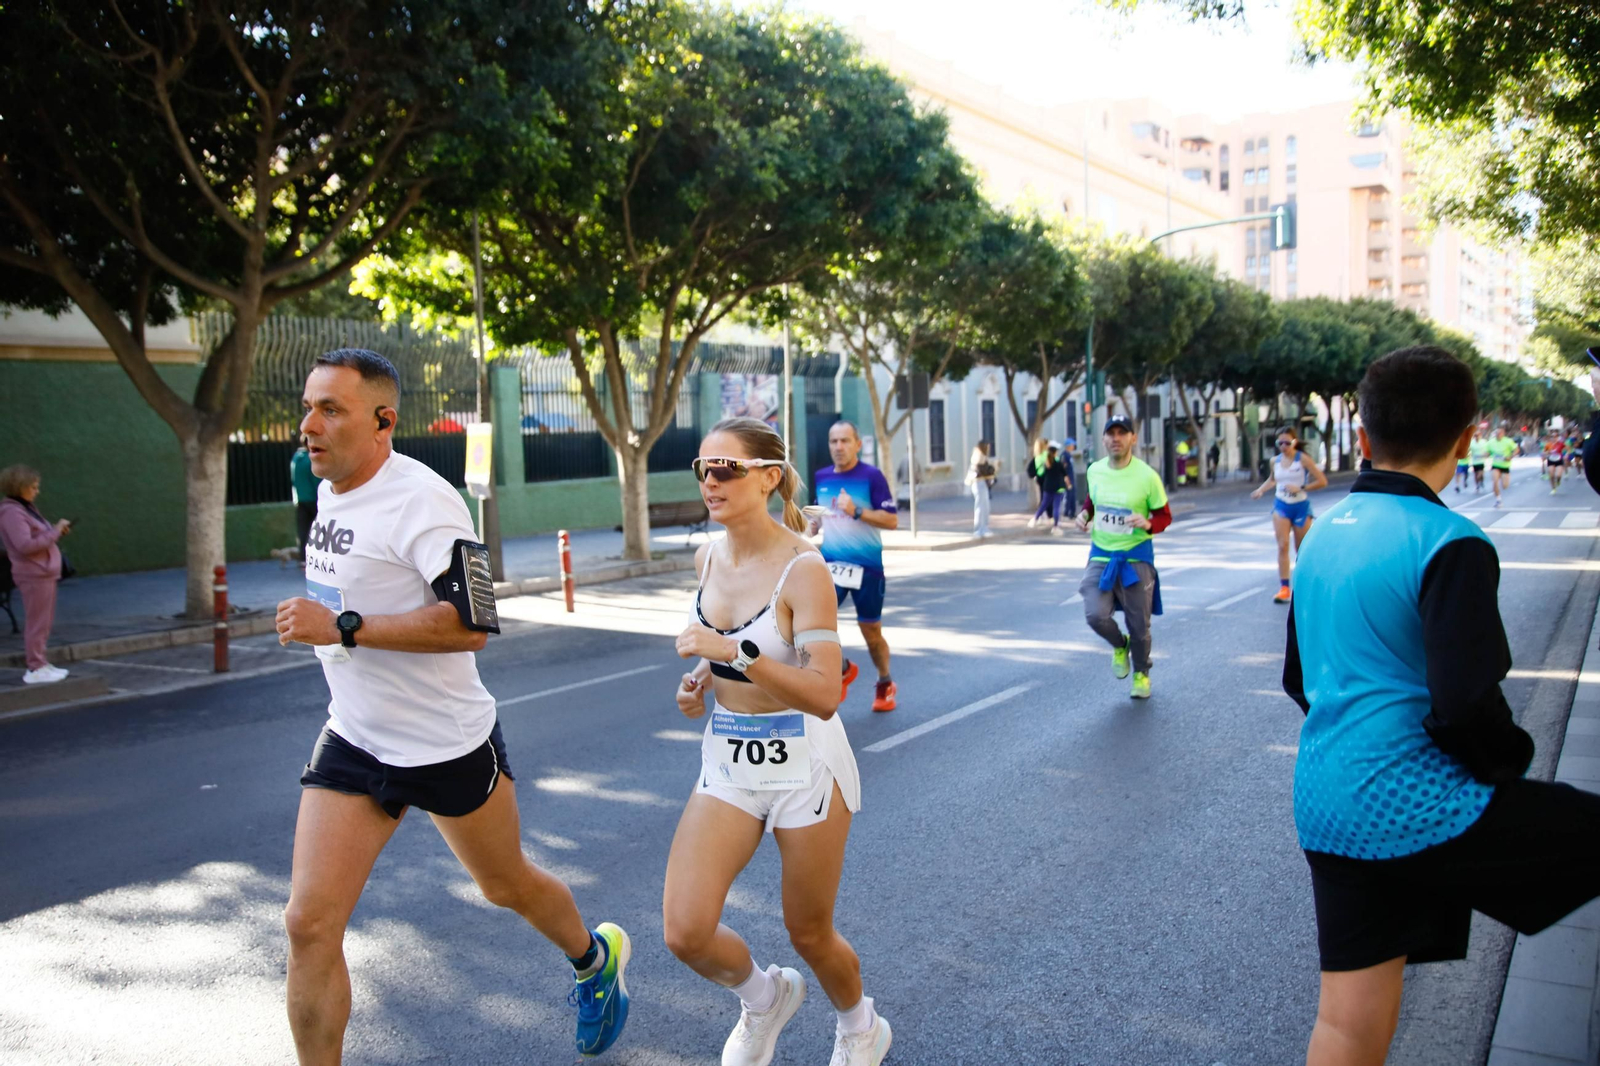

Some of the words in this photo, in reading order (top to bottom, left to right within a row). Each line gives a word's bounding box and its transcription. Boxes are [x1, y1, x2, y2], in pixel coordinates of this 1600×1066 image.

[1102, 513, 1125, 526] 415
[307, 554, 336, 575] PAÑA
[831, 564, 853, 578] 271
[714, 723, 732, 731] contra
[727, 738, 788, 766] 703
